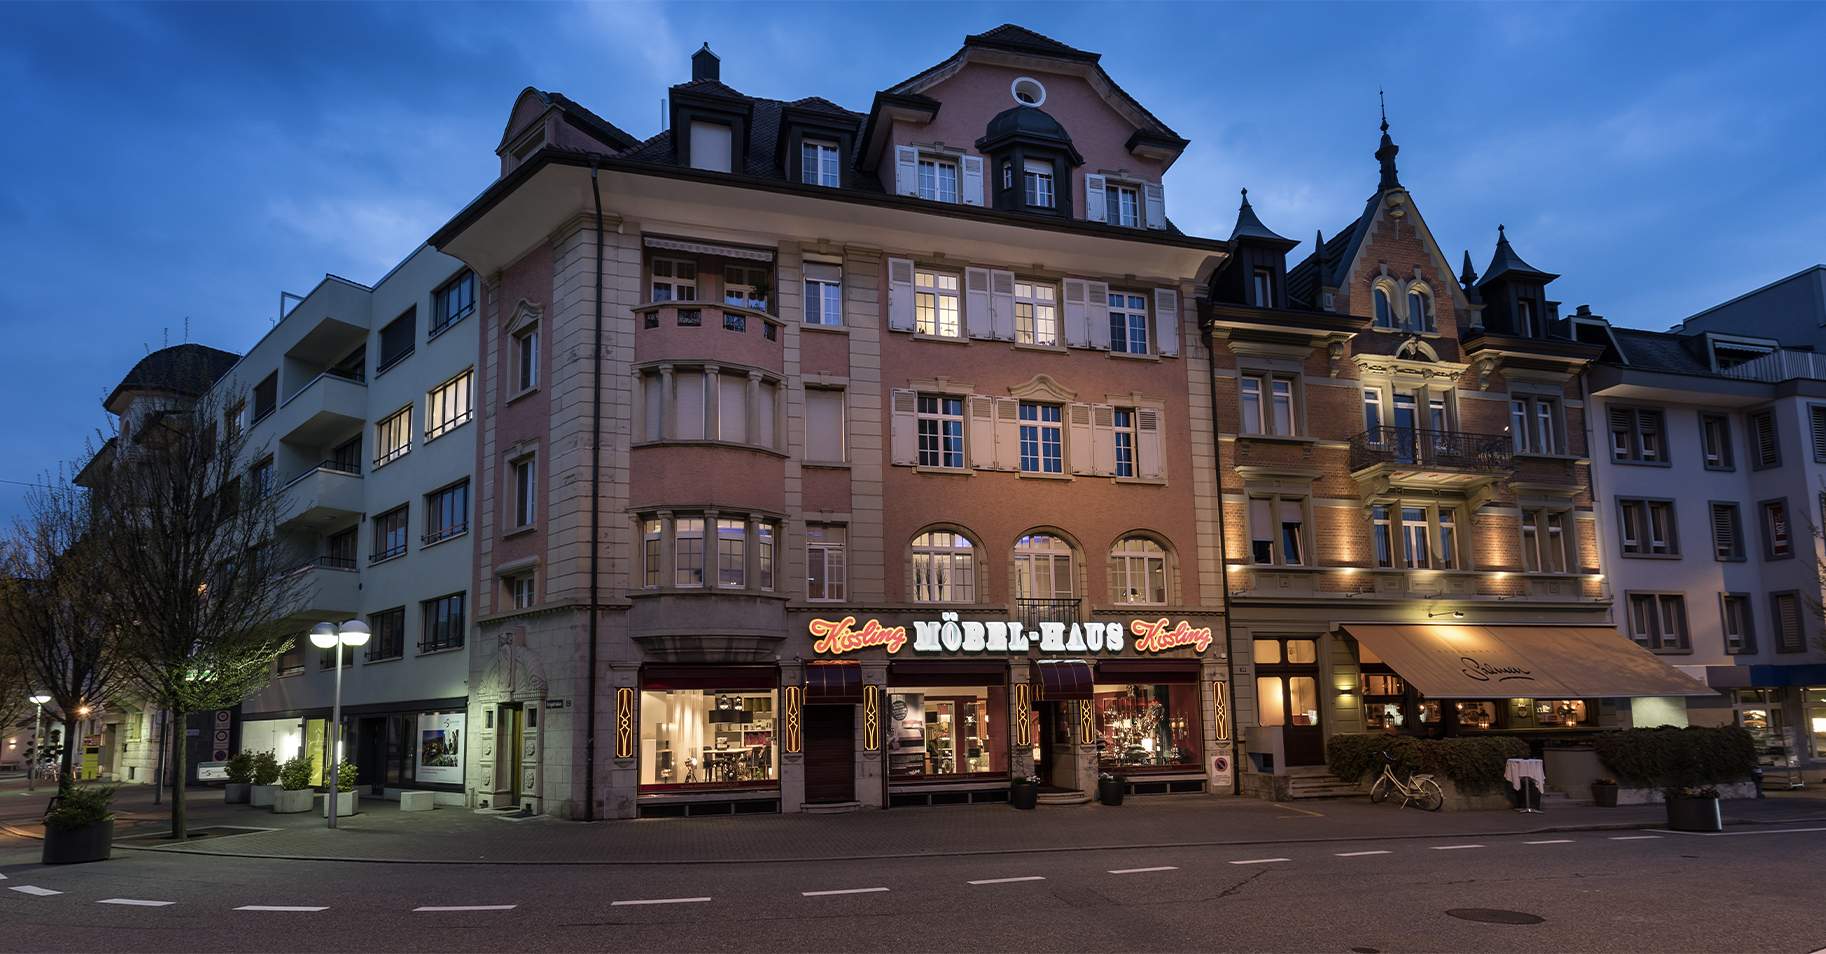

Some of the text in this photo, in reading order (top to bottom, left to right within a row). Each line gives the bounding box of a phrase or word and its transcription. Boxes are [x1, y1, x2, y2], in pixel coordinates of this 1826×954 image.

[809, 612, 1213, 654] Kissling MÖBEL-HAUS Kissling
